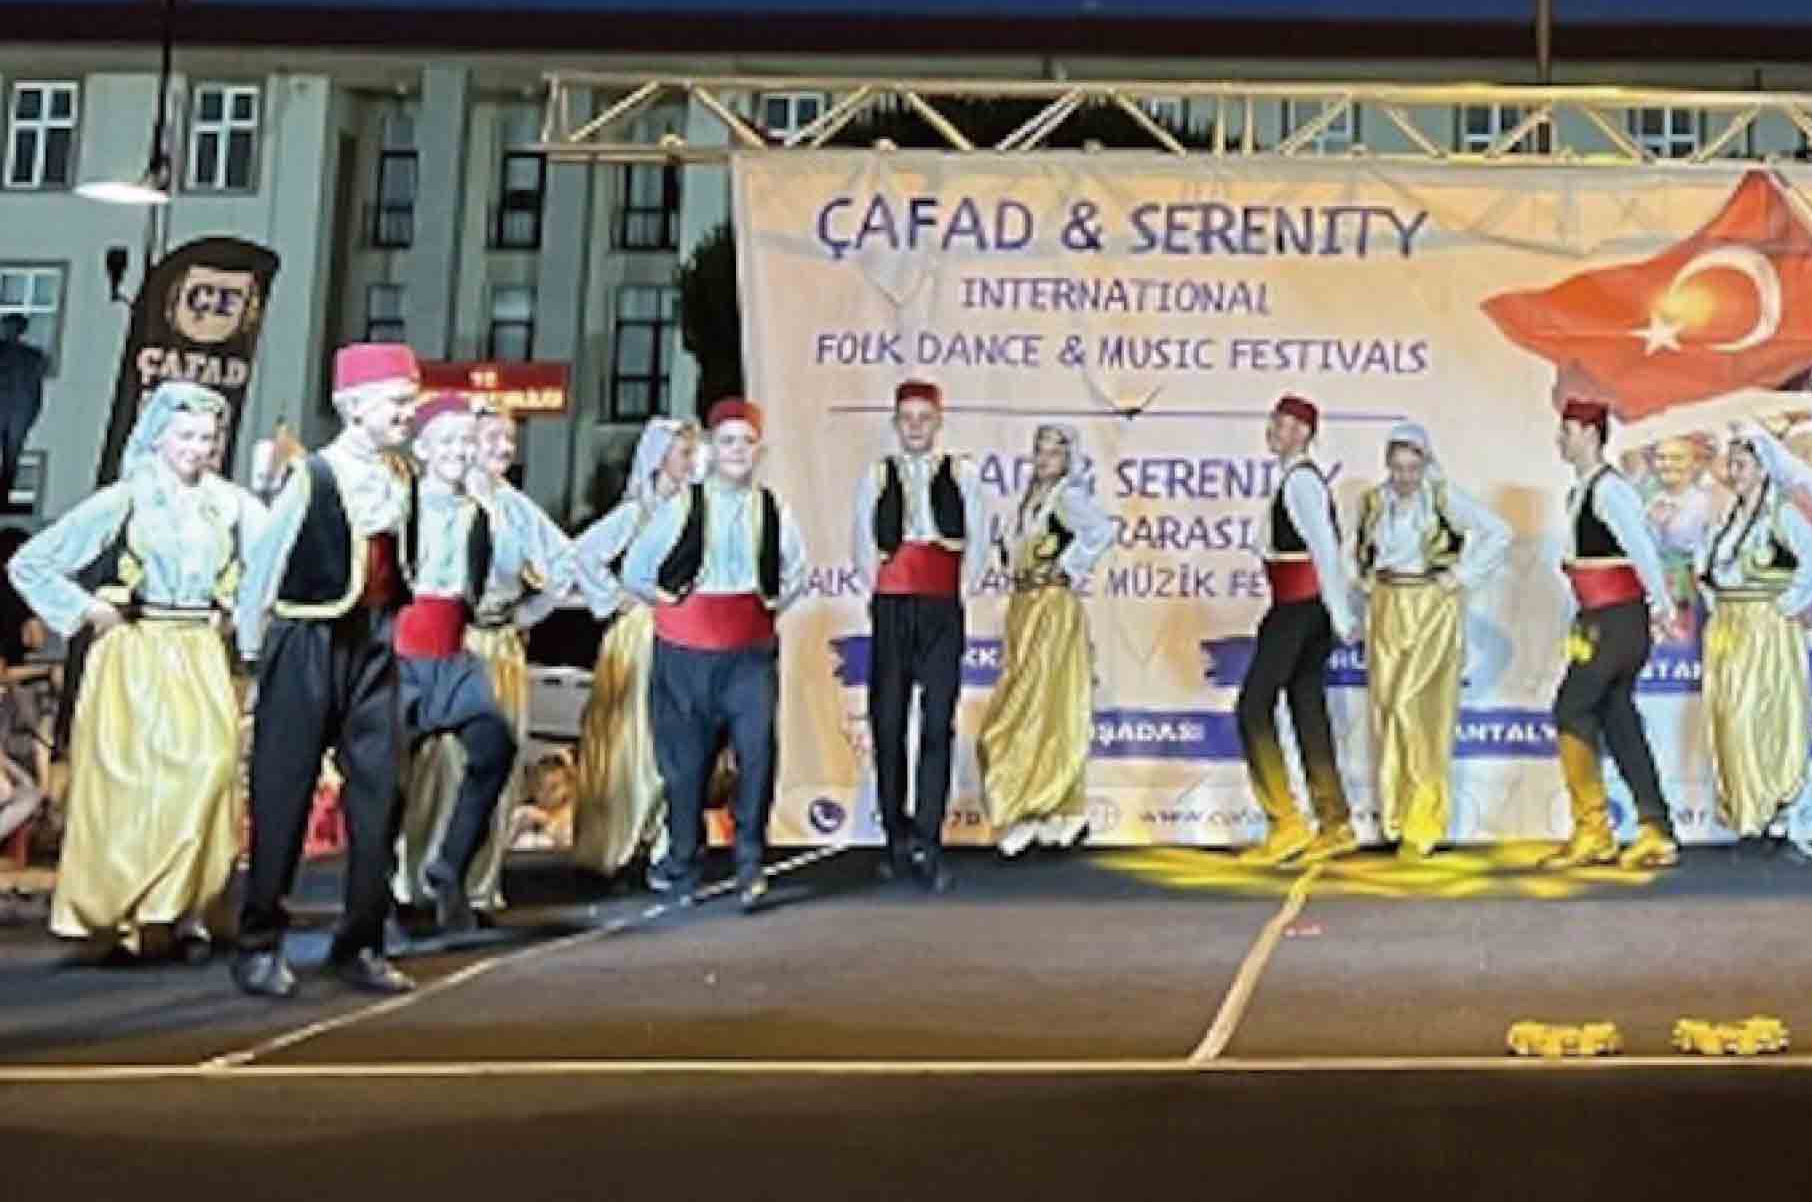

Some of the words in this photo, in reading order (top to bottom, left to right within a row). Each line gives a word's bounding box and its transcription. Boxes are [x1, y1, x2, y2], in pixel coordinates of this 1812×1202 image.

[816, 194, 1034, 260] ÇAFAD
[1060, 203, 1102, 253] &
[1130, 200, 1430, 259] SERENITY
[961, 277, 1271, 315] INTERNATIONAL
[815, 333, 903, 366] FOLK
[917, 333, 1043, 368] DANCE
[1057, 337, 1085, 367] &
[1098, 336, 1215, 371] MUSIC
[1228, 338, 1429, 375] FESTIVALS
[1114, 455, 1343, 500] SERENI
[1105, 561, 1216, 598] MÜZİK
